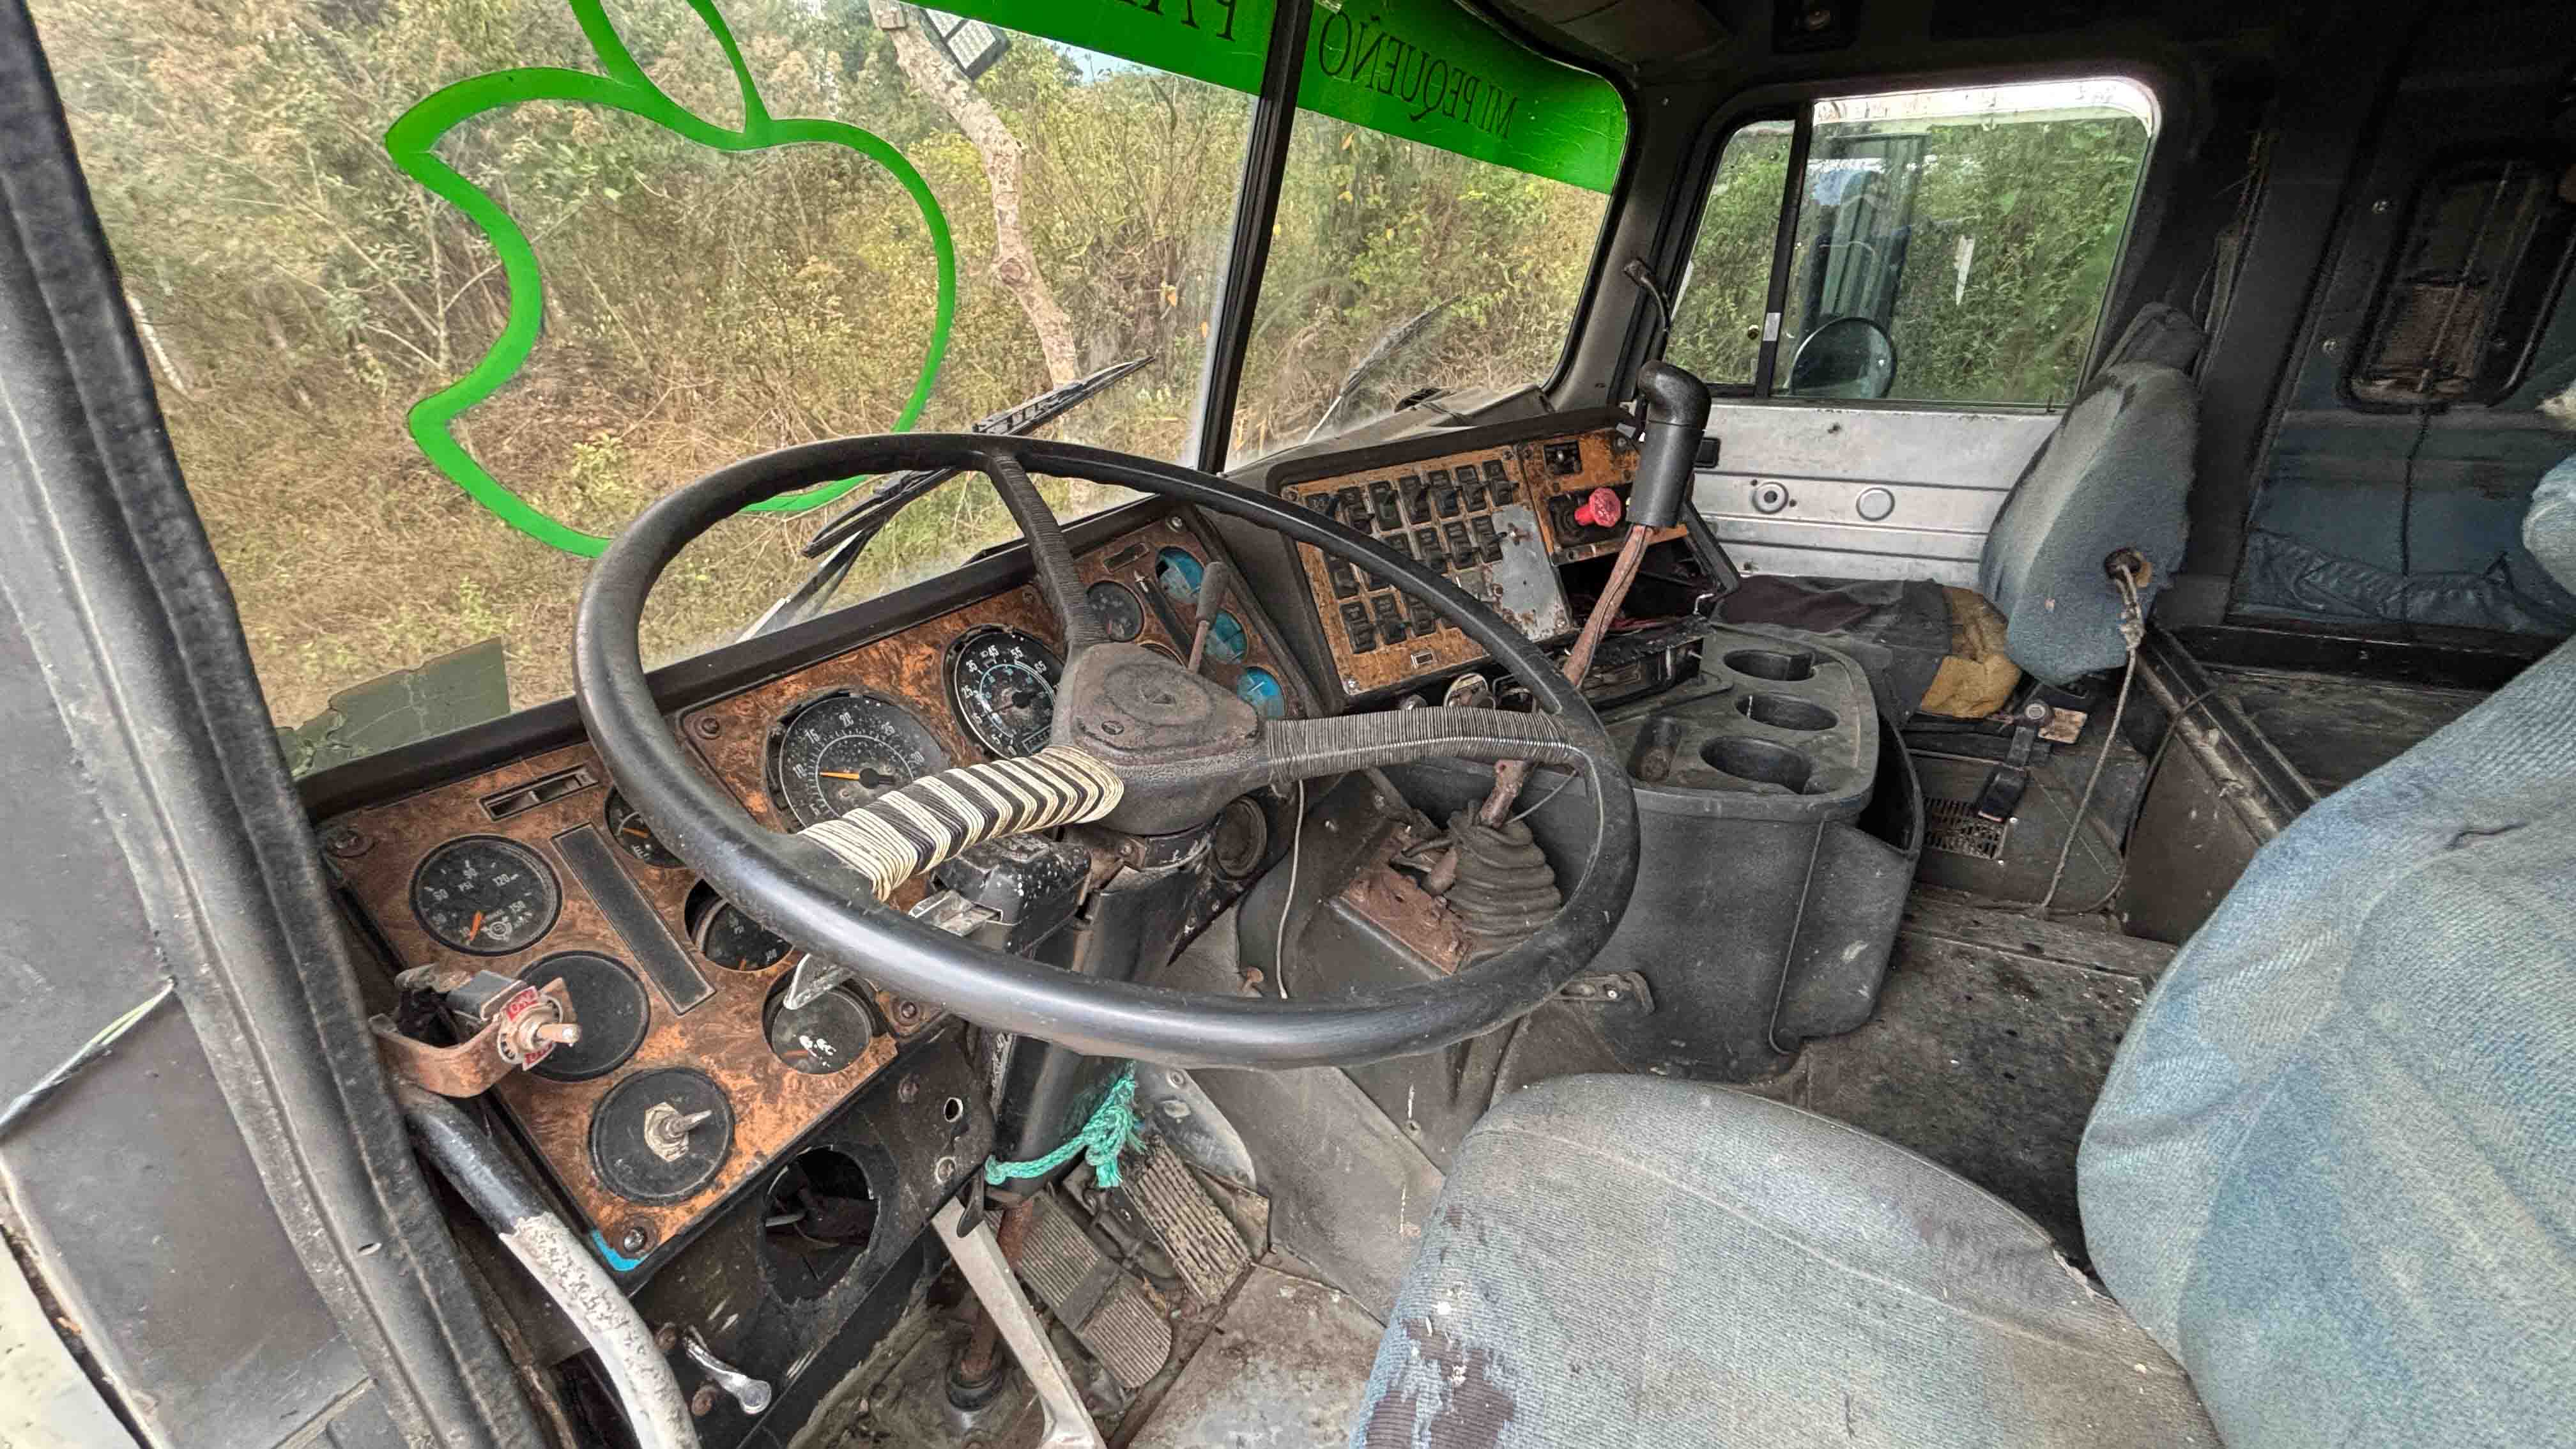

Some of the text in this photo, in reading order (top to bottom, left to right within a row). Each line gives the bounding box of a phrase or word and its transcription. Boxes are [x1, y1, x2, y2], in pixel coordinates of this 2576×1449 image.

[988, 645, 1000, 657] 45
[1010, 646, 1023, 659] 55
[965, 659, 978, 673] 35
[839, 712, 854, 728] 20
